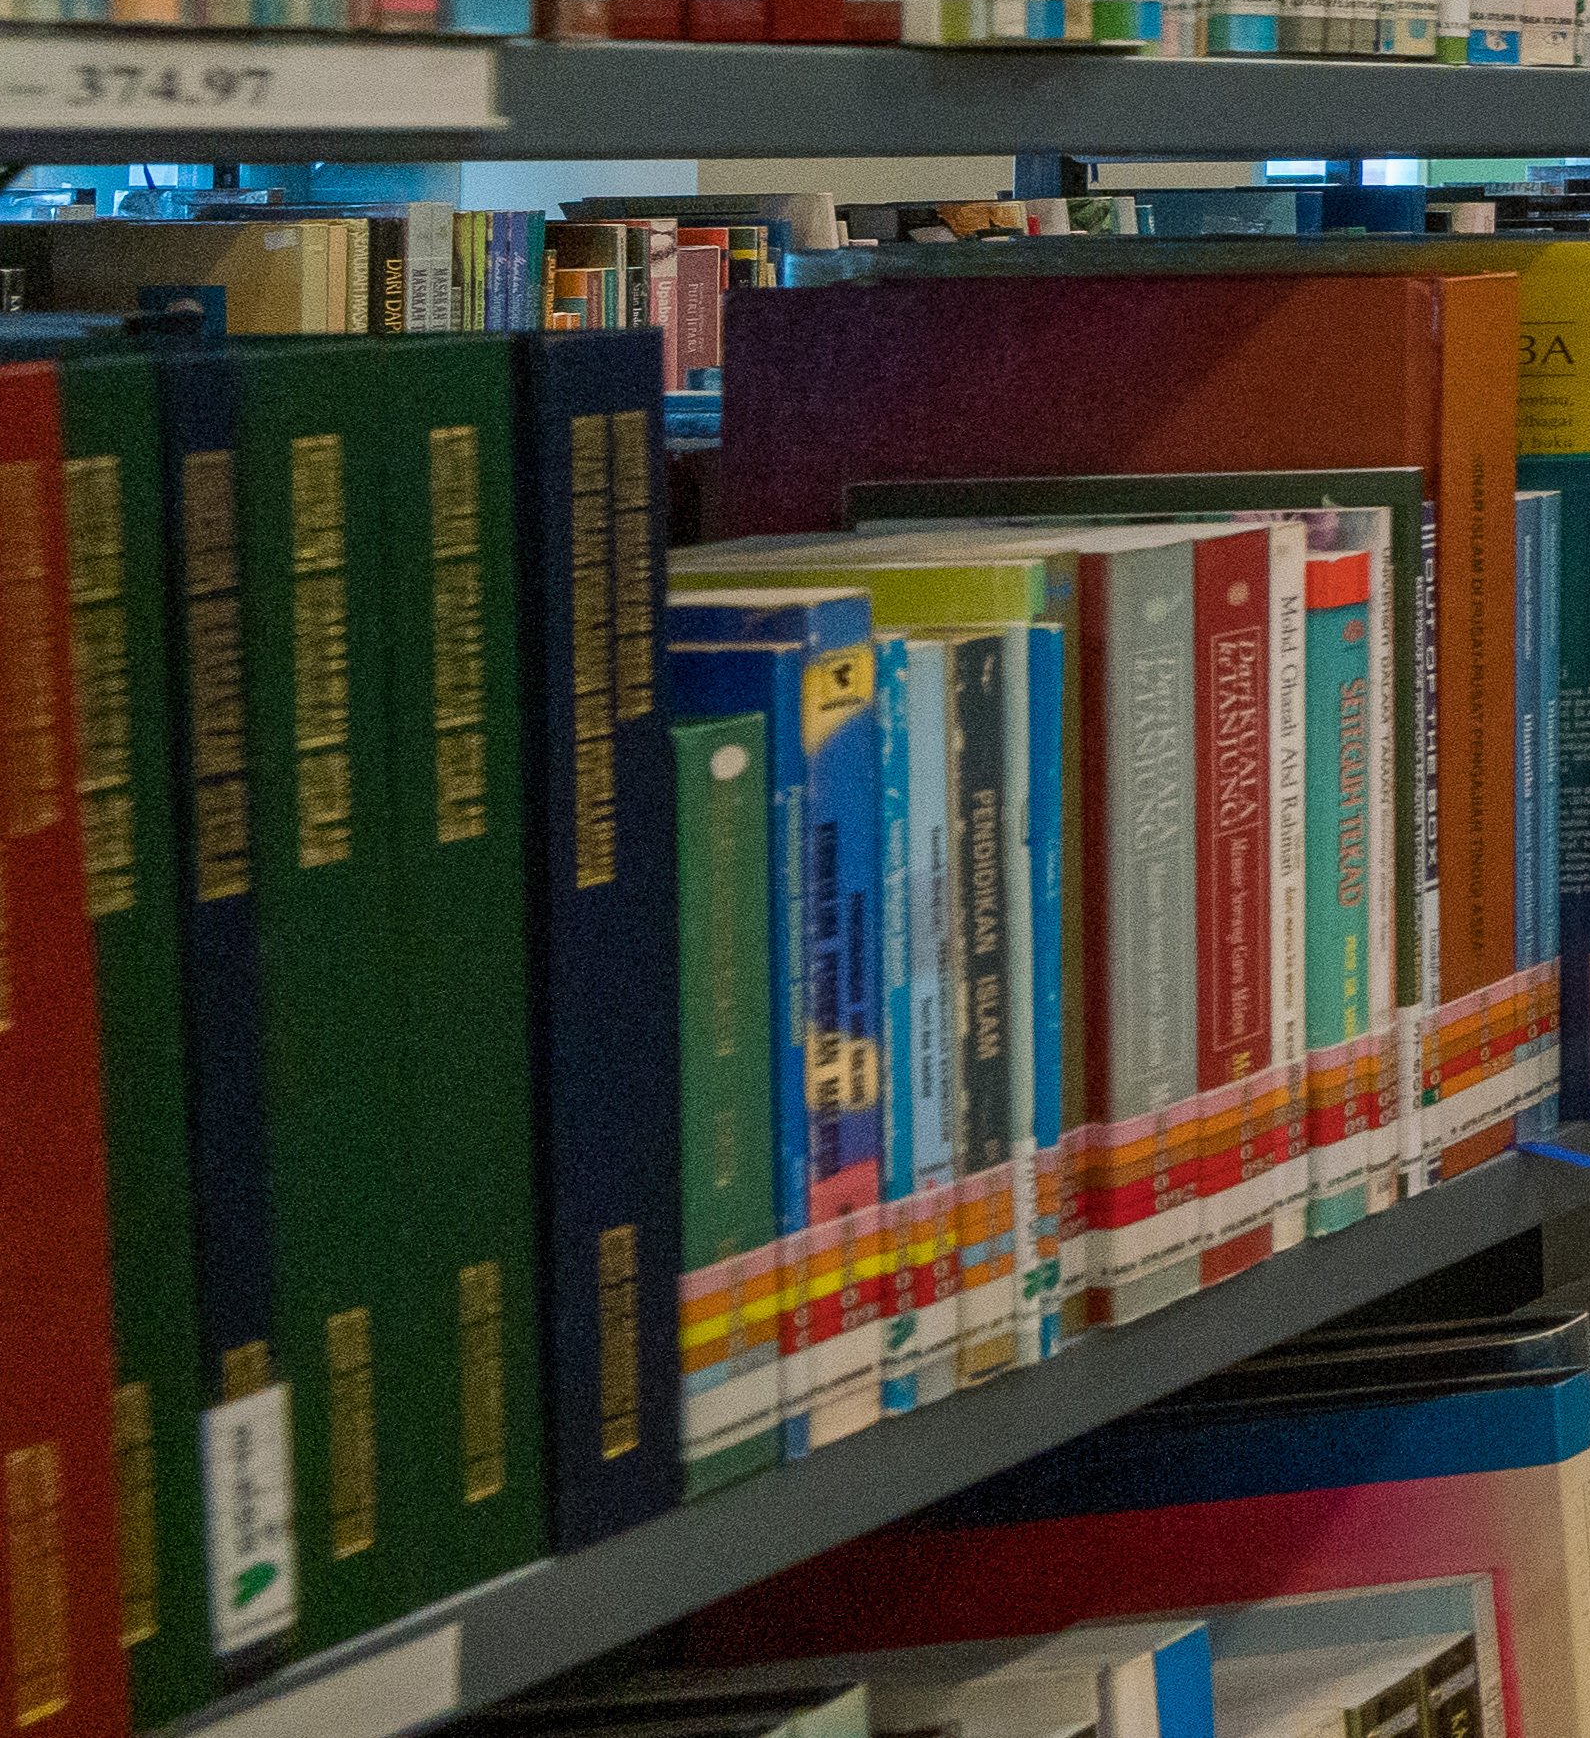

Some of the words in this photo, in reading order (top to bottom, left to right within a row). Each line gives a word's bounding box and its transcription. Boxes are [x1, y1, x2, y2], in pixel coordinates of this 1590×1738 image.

[70, 66, 273, 104] 374.97
[973, 789, 996, 955] PENDIDIKAN
[1338, 813, 1364, 908] TEKAD
[972, 974, 996, 1061] ISLAM
